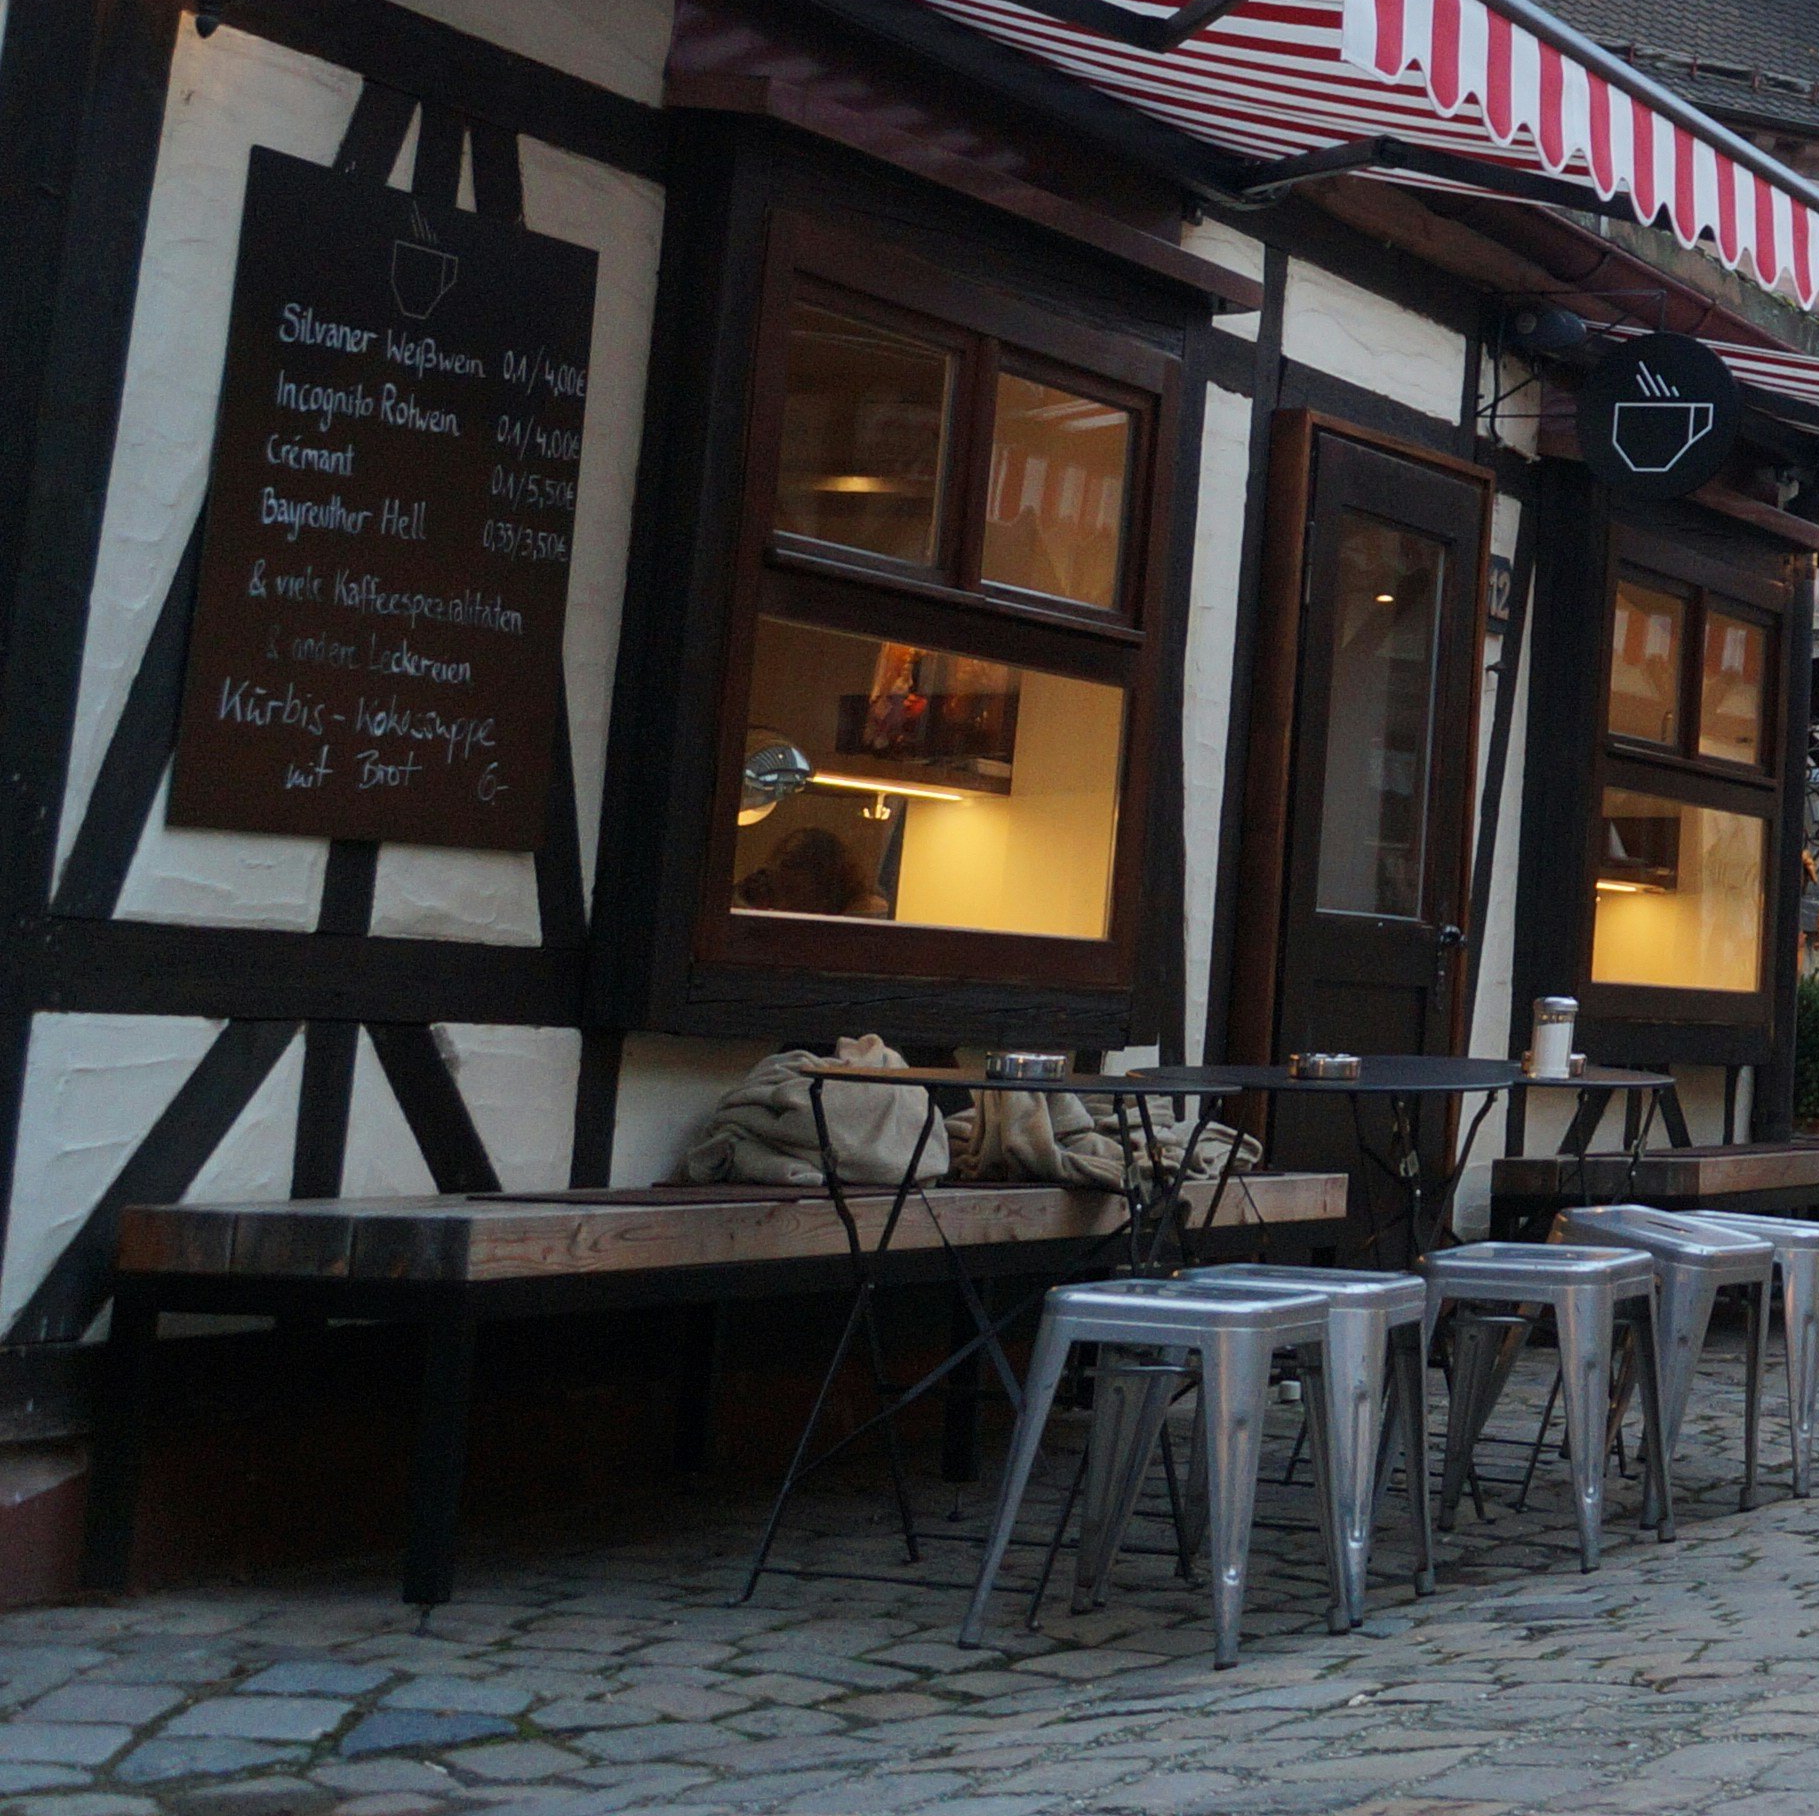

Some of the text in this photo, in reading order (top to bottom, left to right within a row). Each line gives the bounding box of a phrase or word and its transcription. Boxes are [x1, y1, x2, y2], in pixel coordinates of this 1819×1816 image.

[279, 302, 378, 353] Silvaner
[387, 330, 486, 377] Weißwein
[276, 370, 374, 432] Incognito
[381, 383, 460, 436] Rotwein
[267, 434, 355, 475] Crémant
[261, 487, 373, 542] Bayreuther
[381, 498, 427, 540] Hell
[249, 558, 267, 599] &
[276, 565, 323, 603] viele
[1489, 568, 1511, 621] 12
[291, 631, 361, 670] andere
[369, 633, 471, 684] Leckereien
[284, 744, 334, 790] mit
[356, 749, 423, 790] Brot
